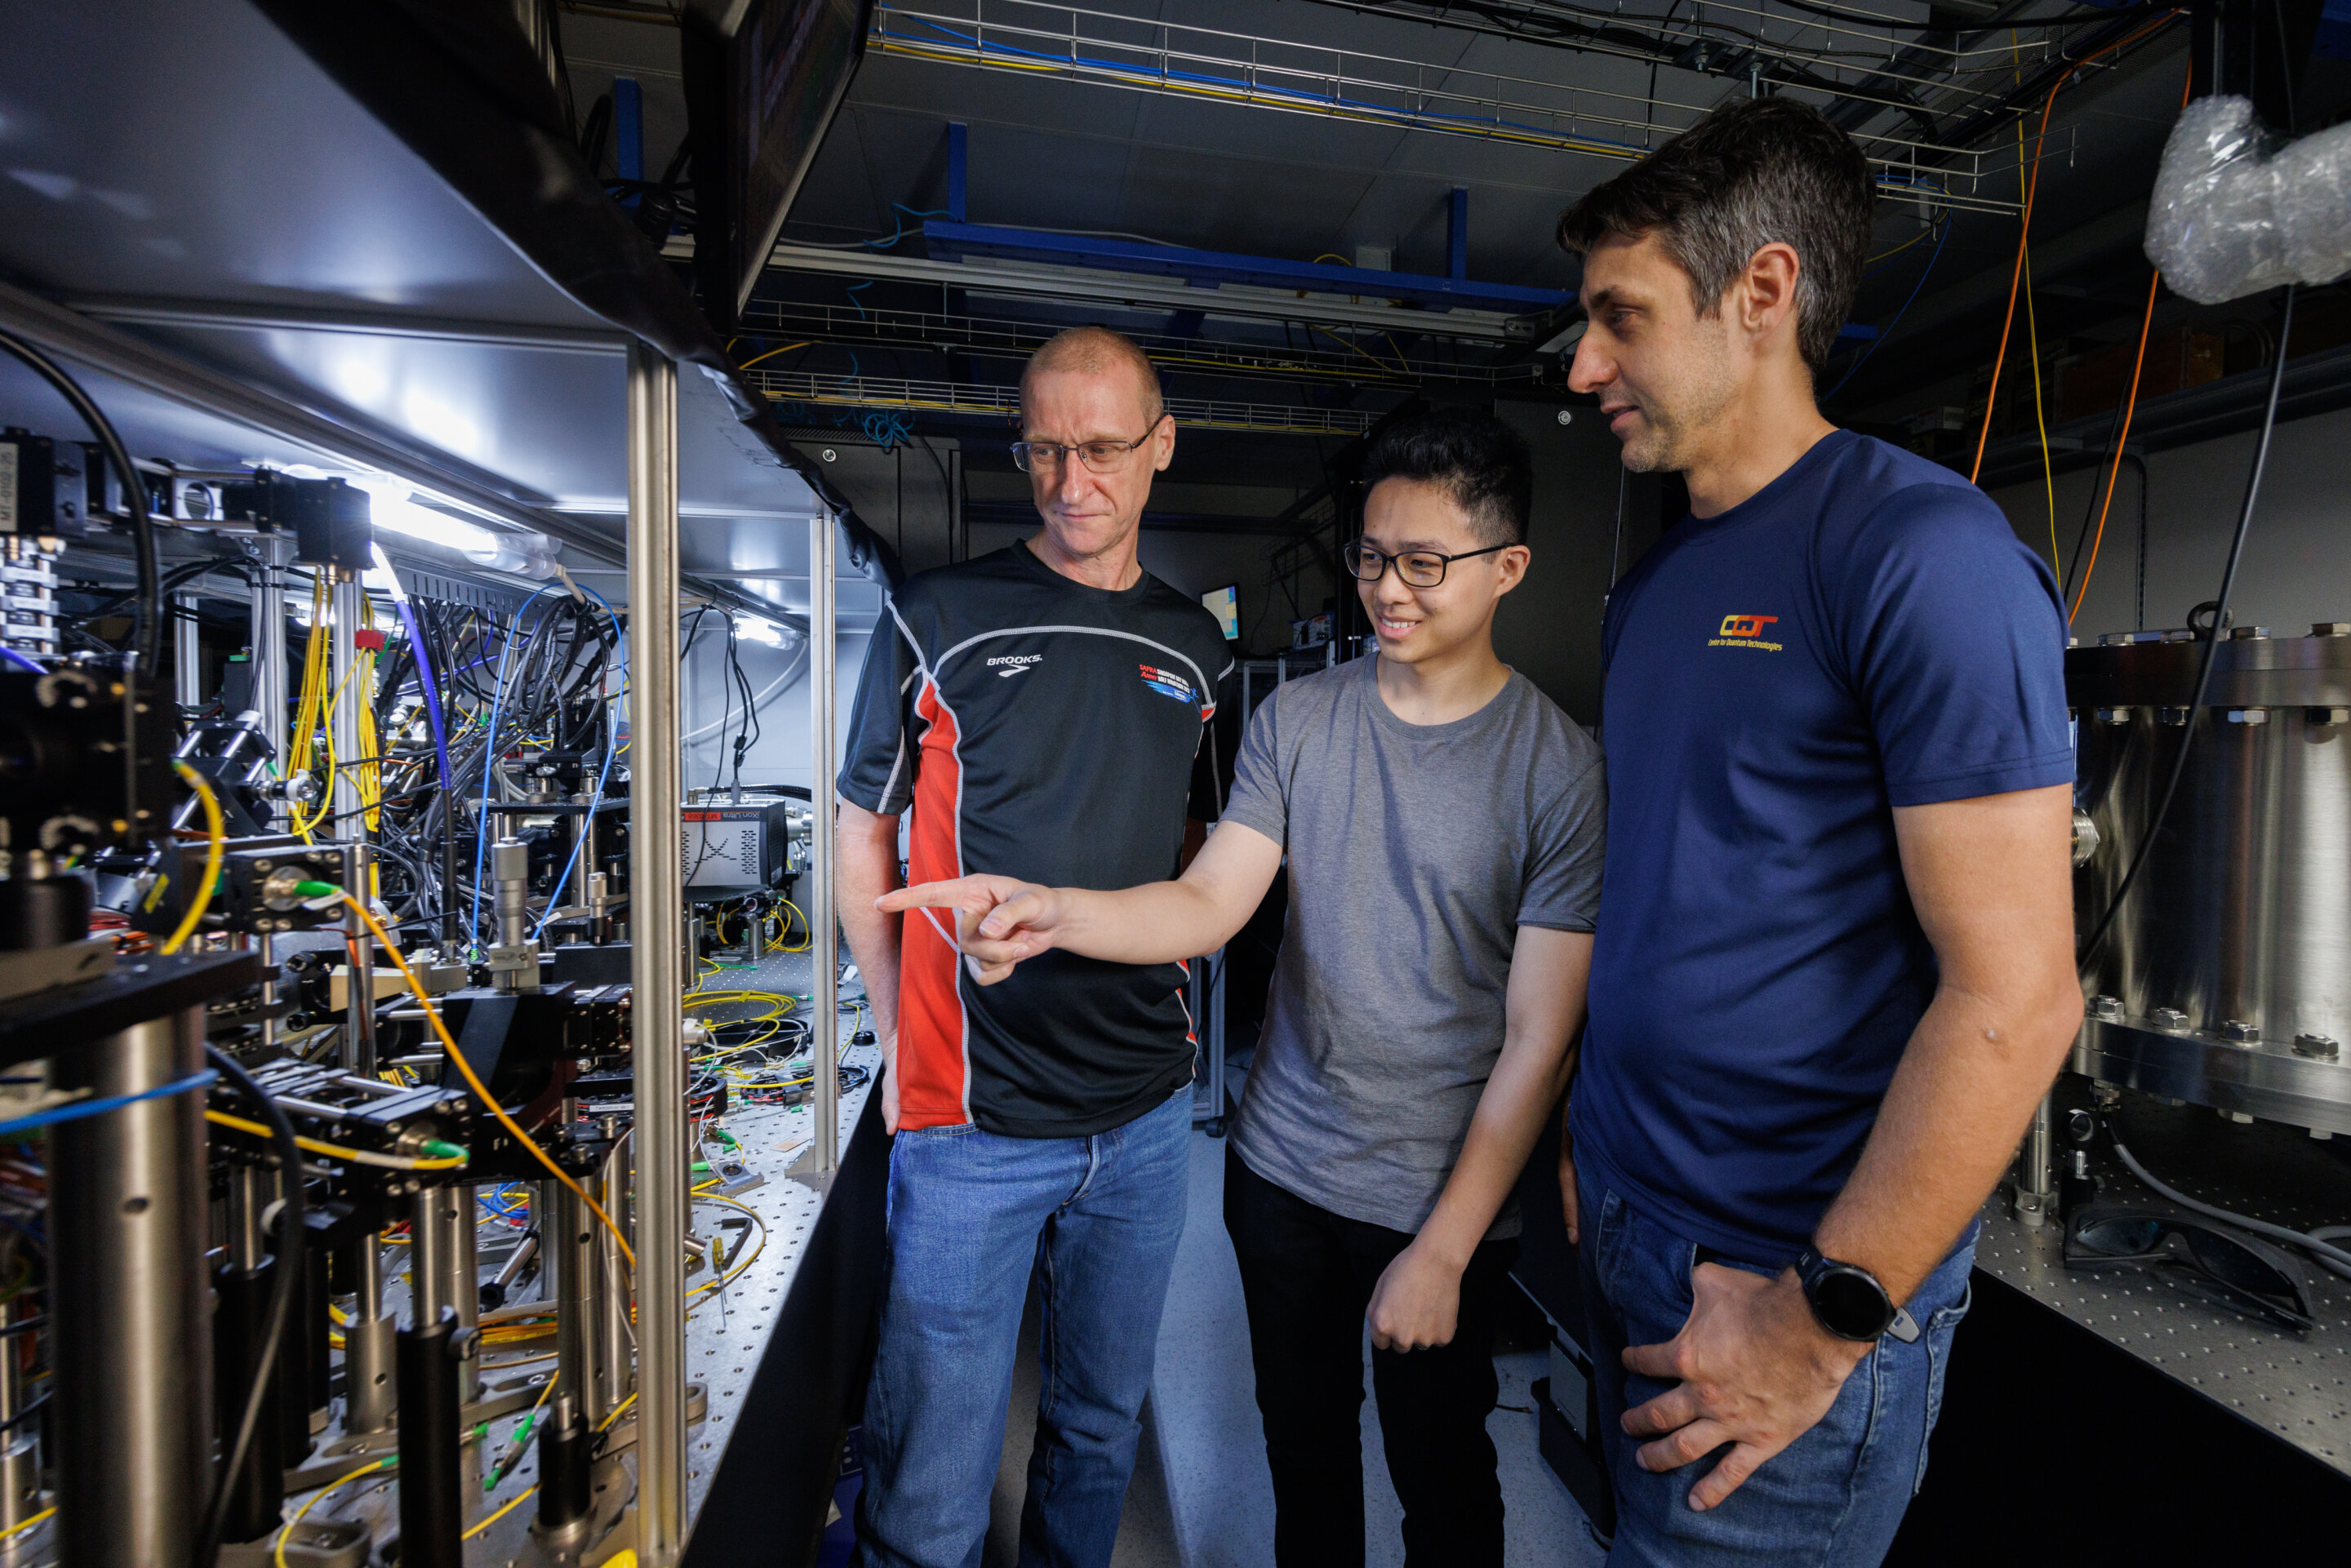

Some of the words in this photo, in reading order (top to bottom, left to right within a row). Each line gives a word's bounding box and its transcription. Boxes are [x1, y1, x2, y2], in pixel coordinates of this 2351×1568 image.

[1719, 615, 1779, 637] CQT
[1727, 638, 1747, 647] Quantum
[1747, 640, 1783, 651] Technologies
[986, 654, 1042, 666] BROOKS
[1139, 664, 1158, 674] SAFRA
